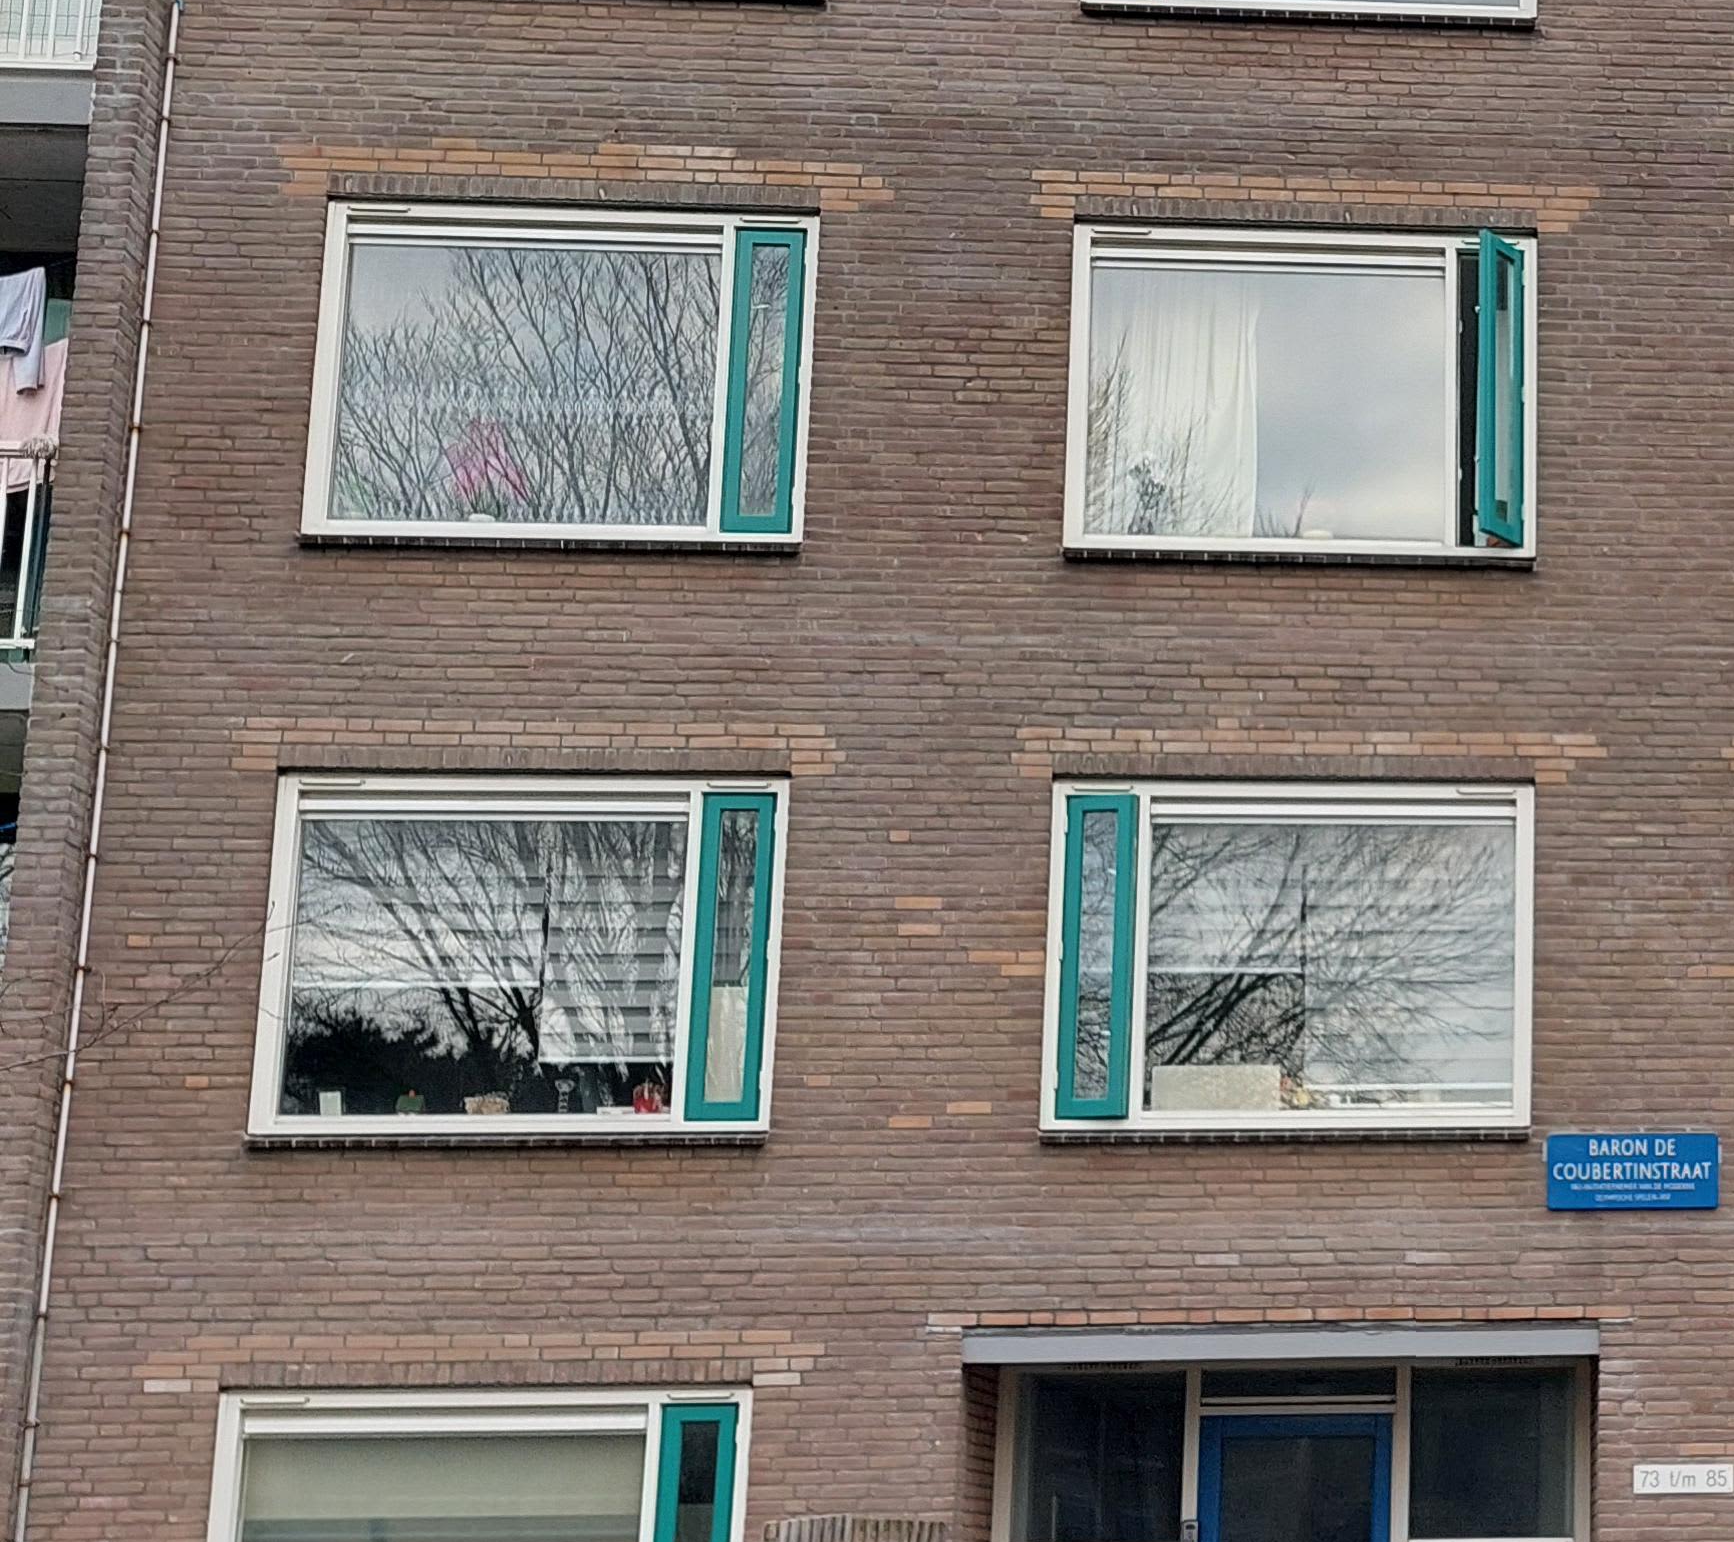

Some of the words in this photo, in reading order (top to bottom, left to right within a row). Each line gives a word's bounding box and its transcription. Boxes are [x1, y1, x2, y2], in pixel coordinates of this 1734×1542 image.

[1588, 1138, 1648, 1157] BARON
[1654, 1138, 1677, 1157] DE
[1552, 1161, 1712, 1181] COUBERTINSTRAAT
[1639, 1470, 1660, 1488] 73
[1669, 1470, 1696, 1488] t/m
[1705, 1469, 1727, 1487] 85
